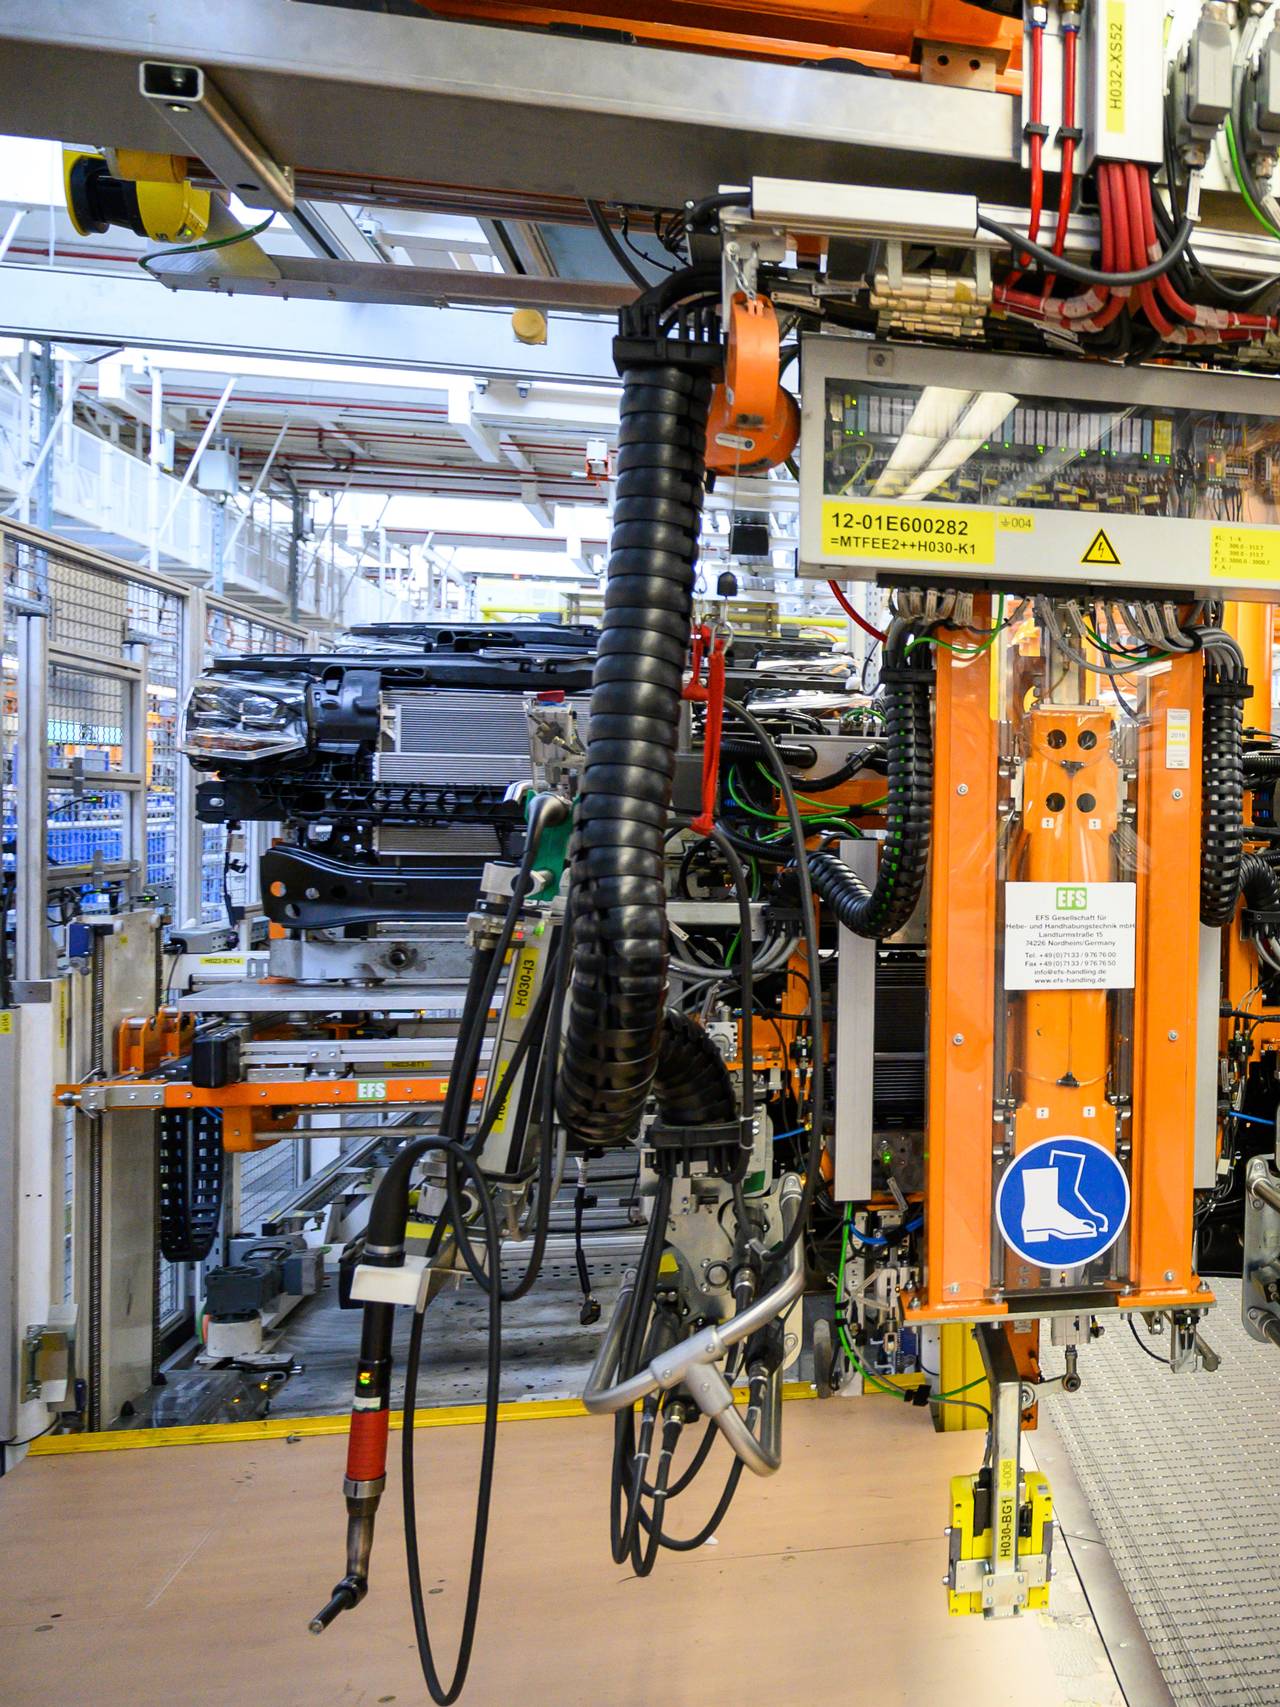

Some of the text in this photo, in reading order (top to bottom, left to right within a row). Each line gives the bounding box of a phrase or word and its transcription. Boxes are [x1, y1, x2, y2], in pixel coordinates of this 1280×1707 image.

[1109, 22, 1123, 110] H032-XS52
[831, 511, 969, 536] 12-01E600282
[1011, 517, 1032, 529] 004
[830, 535, 976, 555] =MTFEE2++H030-K1
[1057, 889, 1087, 909] EFS
[357, 1082, 386, 1099] EFS
[1000, 1497, 1013, 1557] H030-BG1
